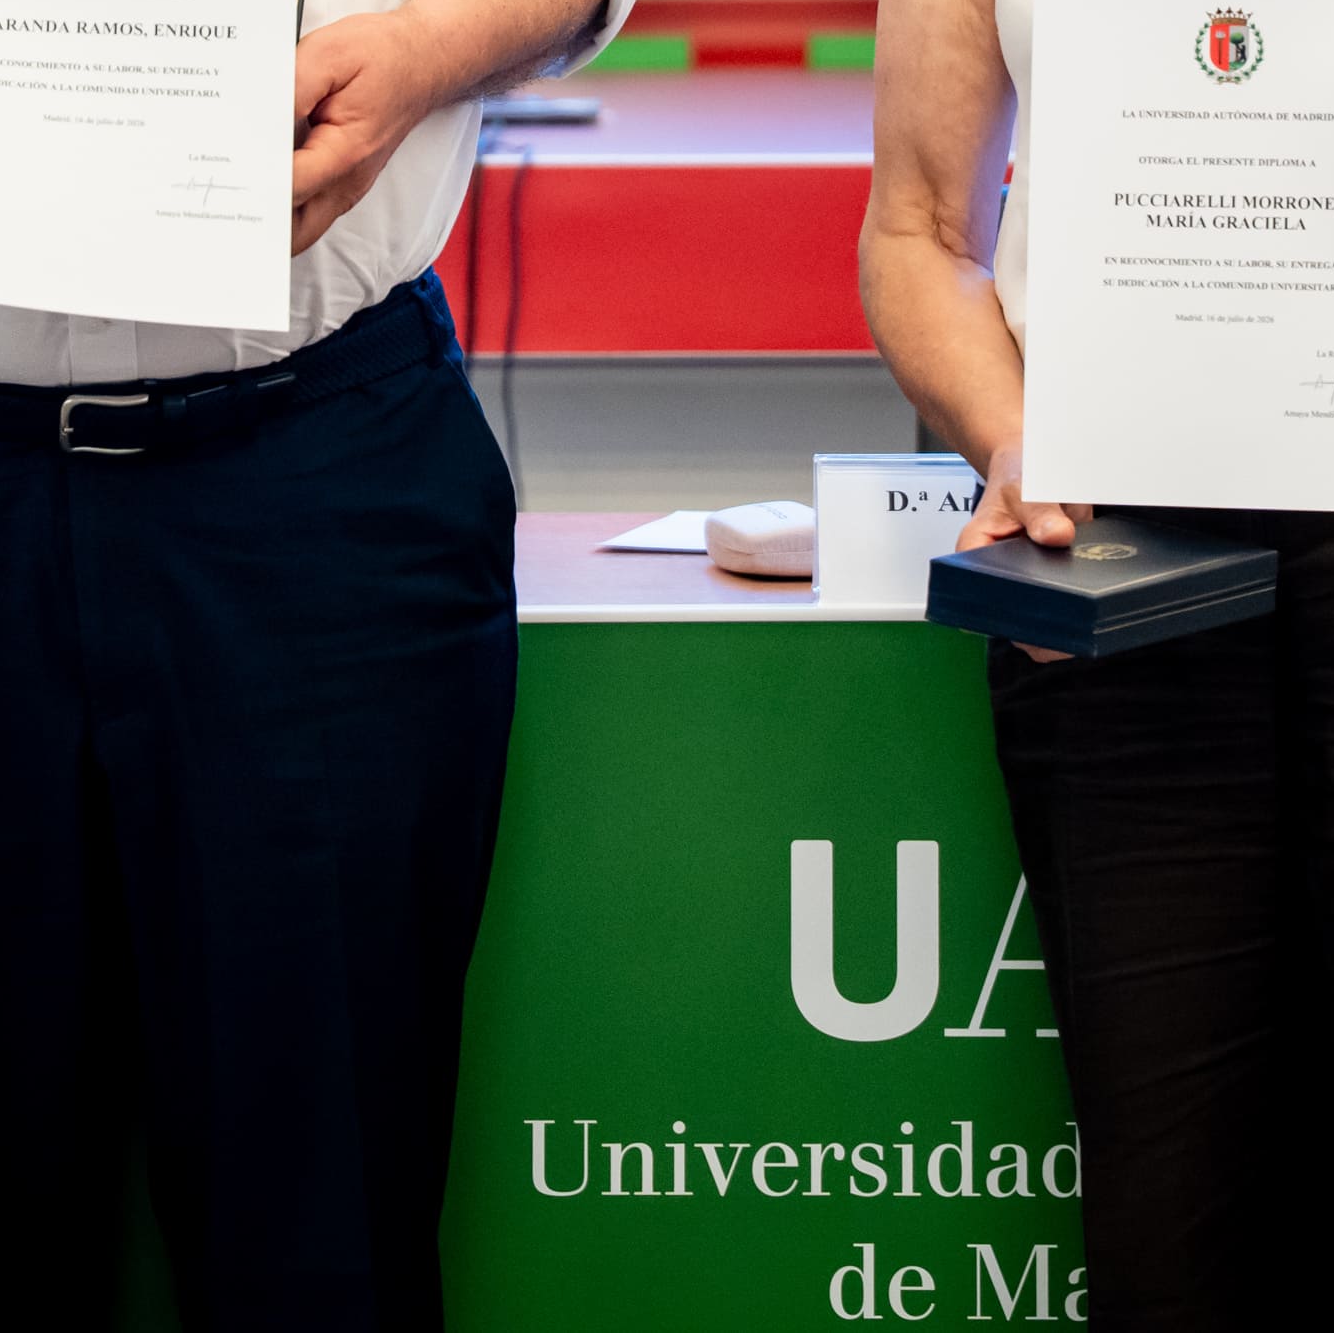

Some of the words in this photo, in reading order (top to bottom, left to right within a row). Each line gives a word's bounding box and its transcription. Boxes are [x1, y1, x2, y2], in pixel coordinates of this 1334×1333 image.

[76, 21, 148, 37] RAMOS,
[154, 23, 238, 41] ENRIQUE
[82, 62, 90, 71] A
[92, 62, 106, 71] SU
[147, 66, 160, 74] SU
[163, 66, 210, 76] ENTREGA
[212, 68, 219, 76] Y
[50, 82, 57, 90] A
[59, 83, 73, 91] LA
[75, 83, 139, 95] COMUNIDAD
[141, 86, 220, 98] UNIVERSITARIA
[1122, 109, 1136, 118] LA
[1139, 110, 1210, 120] UNIVERSIDAD
[1212, 109, 1274, 121] AUTÓNOMA
[1275, 112, 1290, 121] DE
[1292, 112, 1334, 122] MADRID
[1138, 155, 1184, 165] OTORGA
[1186, 156, 1200, 165] EL
[1202, 157, 1256, 167] PRESENTE
[1258, 158, 1307, 168] DIPLOMA
[1309, 159, 1316, 168] A
[1114, 192, 1237, 209] PUCCIARELLI
[1146, 211, 1207, 229] MARÍA
[1212, 215, 1307, 231] GRACIELA
[1105, 256, 1118, 265] EN
[1120, 256, 1212, 267] RECONOCIMIENTO
[1214, 259, 1222, 267] A
[1223, 259, 1236, 267] SU
[1276, 260, 1289, 268] SU
[1103, 278, 1116, 287] SU
[1117, 278, 1180, 289] DEDICACIÓN
[1182, 280, 1189, 289] A
[1191, 280, 1205, 289] LA
[1207, 280, 1269, 291] COMUNIDAD
[524, 1119, 1083, 1198] Universidad
[829, 1243, 936, 1321] de
